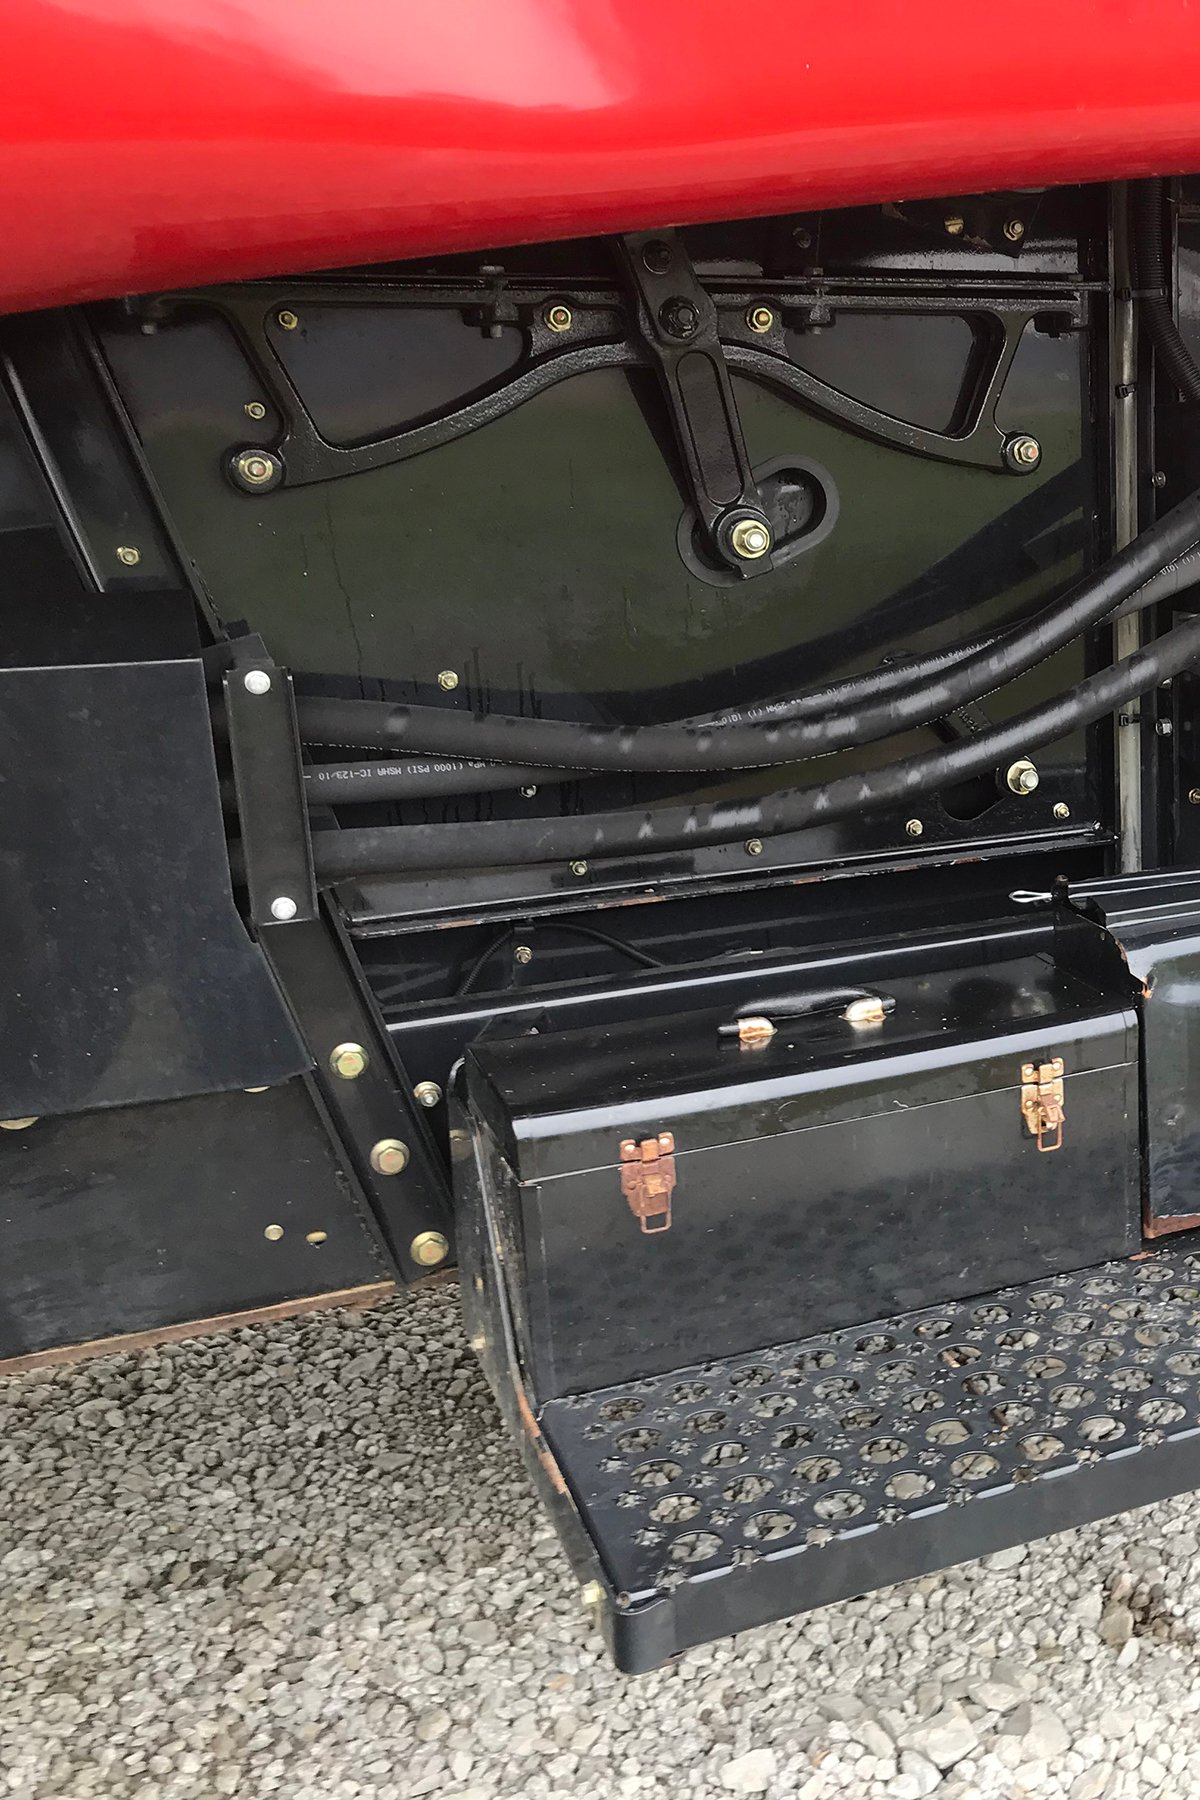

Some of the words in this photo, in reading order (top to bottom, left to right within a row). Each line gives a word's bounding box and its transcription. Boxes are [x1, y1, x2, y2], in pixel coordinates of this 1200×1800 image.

[377, 767, 401, 776] MSHA
[407, 765, 430, 774] PSI)
[434, 763, 463, 772] (1000
[318, 769, 372, 781] IC-123/10
